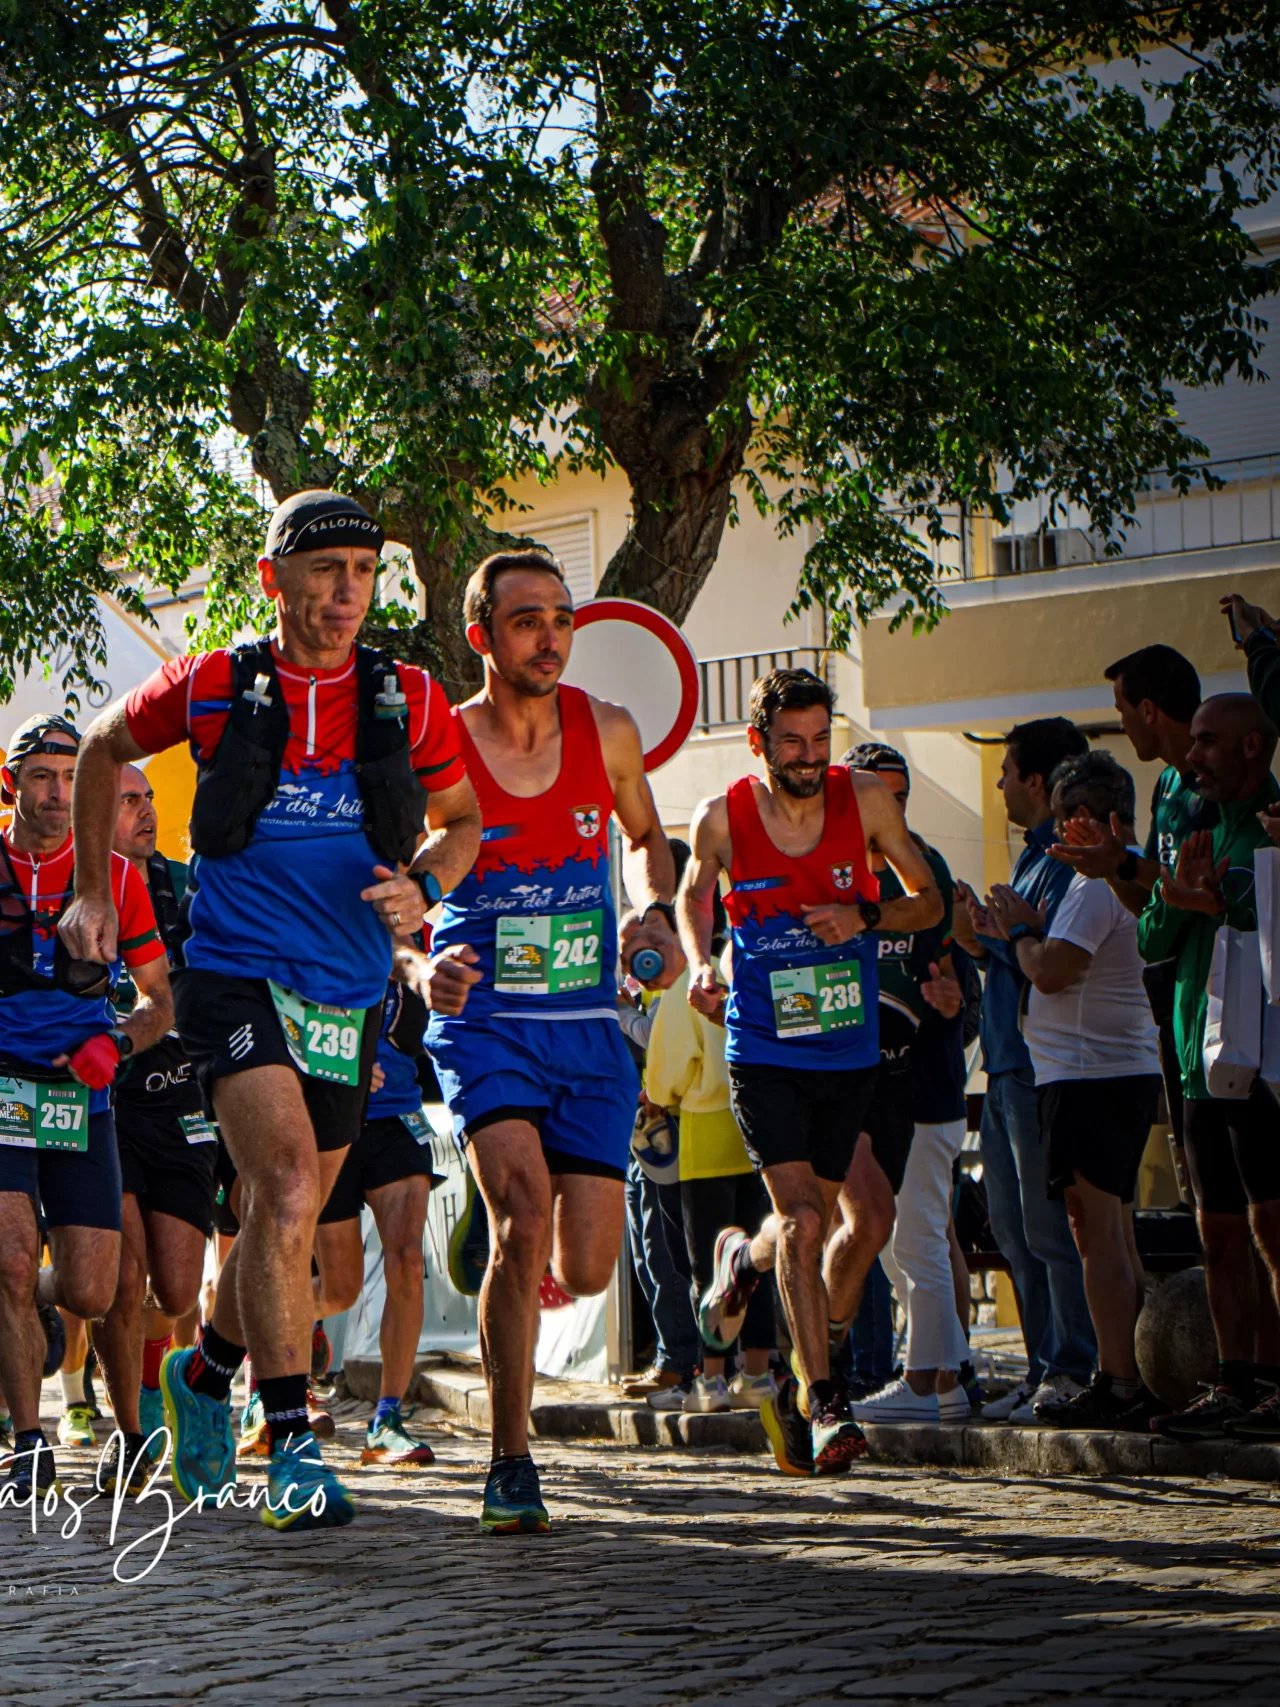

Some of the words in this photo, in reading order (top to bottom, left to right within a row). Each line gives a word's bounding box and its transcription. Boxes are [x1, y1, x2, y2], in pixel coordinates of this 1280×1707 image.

[308, 518, 380, 534] SALOMON
[522, 892, 553, 908] dos
[552, 935, 599, 969] 242
[819, 981, 861, 1012] 238
[306, 1020, 359, 1061] 239
[145, 1062, 192, 1092] ONE
[40, 1102, 84, 1130] 257
